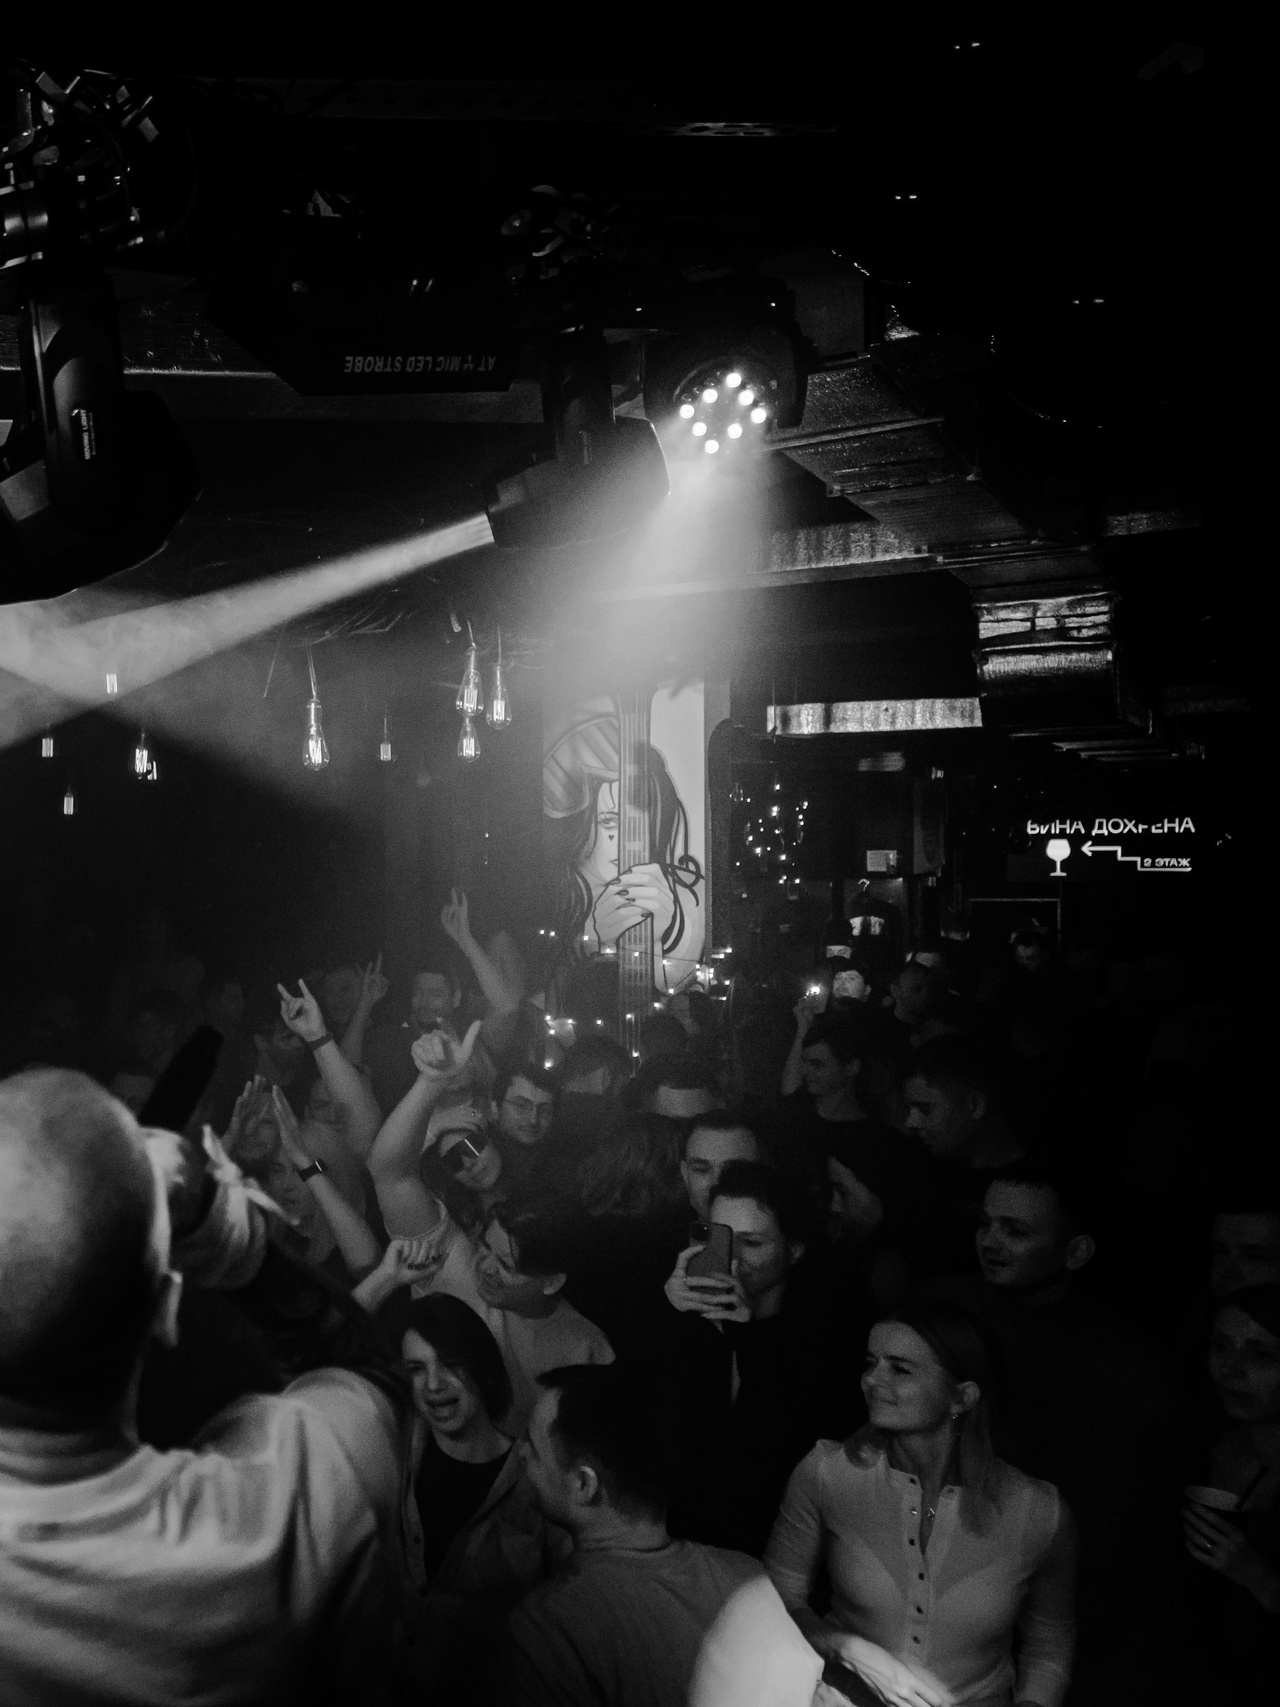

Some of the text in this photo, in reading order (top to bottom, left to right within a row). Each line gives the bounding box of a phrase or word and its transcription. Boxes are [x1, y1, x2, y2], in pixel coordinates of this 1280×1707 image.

[344, 356, 403, 372] STROBE
[406, 356, 433, 372] LED
[1155, 857, 1192, 868] ЭТАЖ
